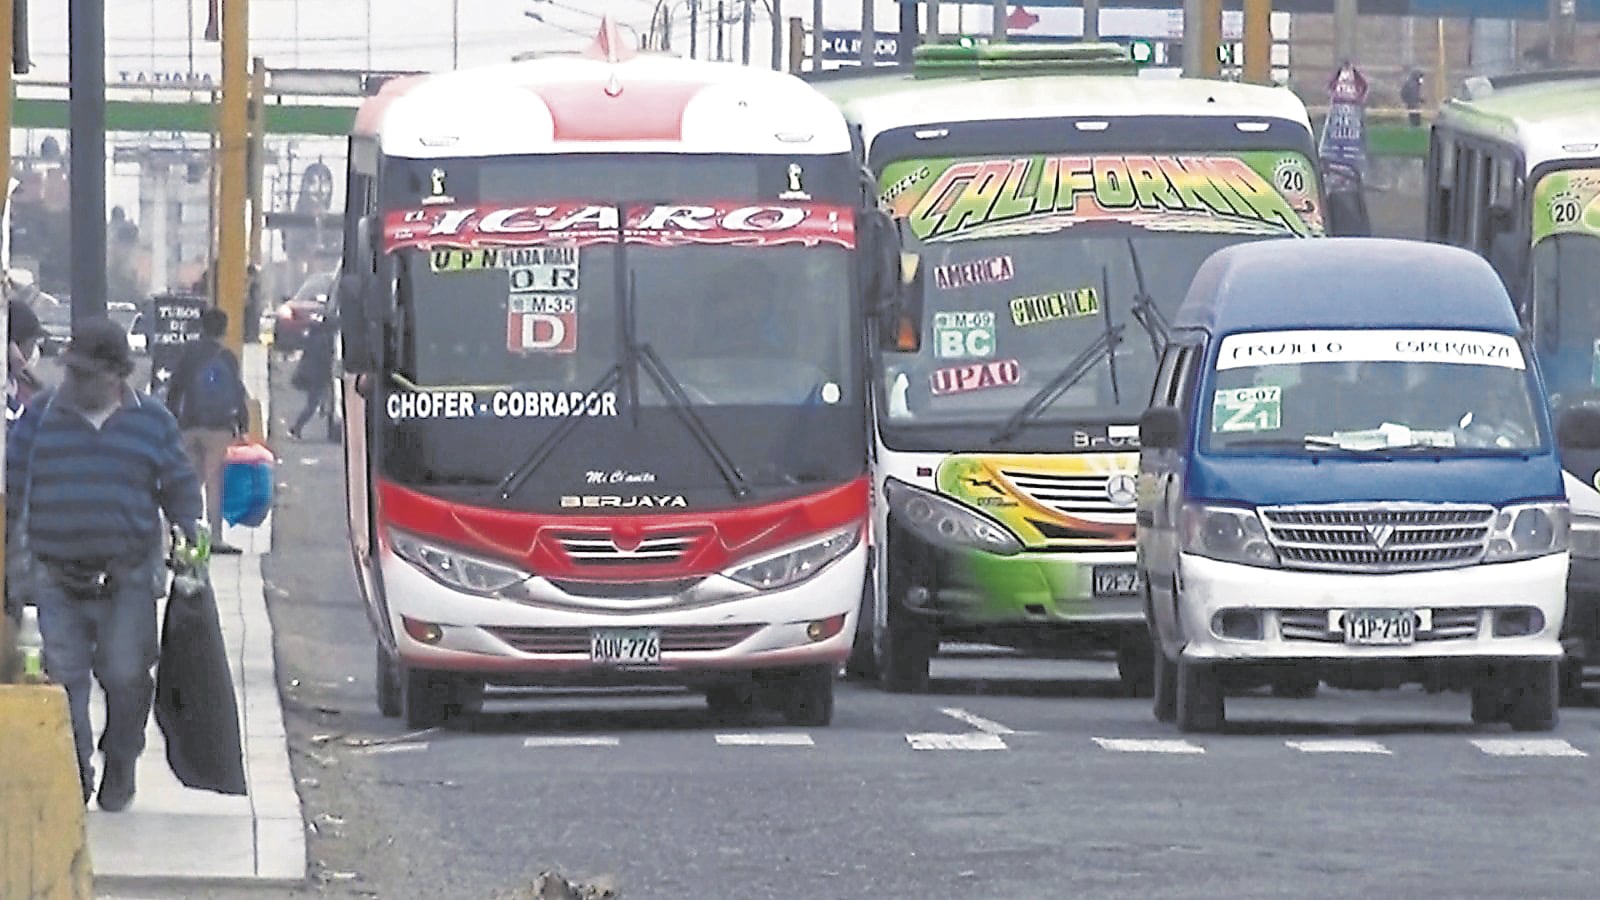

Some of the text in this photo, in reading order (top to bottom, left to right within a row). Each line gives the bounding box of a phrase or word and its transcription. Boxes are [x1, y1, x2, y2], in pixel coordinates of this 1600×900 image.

[1281, 169, 1304, 191] 20
[911, 156, 1307, 240] CALIFORNIA
[429, 205, 806, 236] ICARO
[1554, 202, 1576, 222] 20
[938, 257, 1012, 289] AMERICA
[532, 297, 573, 312] M-35
[522, 313, 565, 349] D
[954, 314, 991, 327] M-09
[940, 328, 991, 357] BC
[931, 362, 1019, 393] UPAO
[386, 391, 475, 418] CHOFER
[493, 391, 617, 417] COBRADOR
[1236, 390, 1277, 402] C-07
[560, 495, 688, 508] BERJAYA
[1347, 617, 1411, 639] Y1P-710
[594, 638, 657, 659] AUV-776
